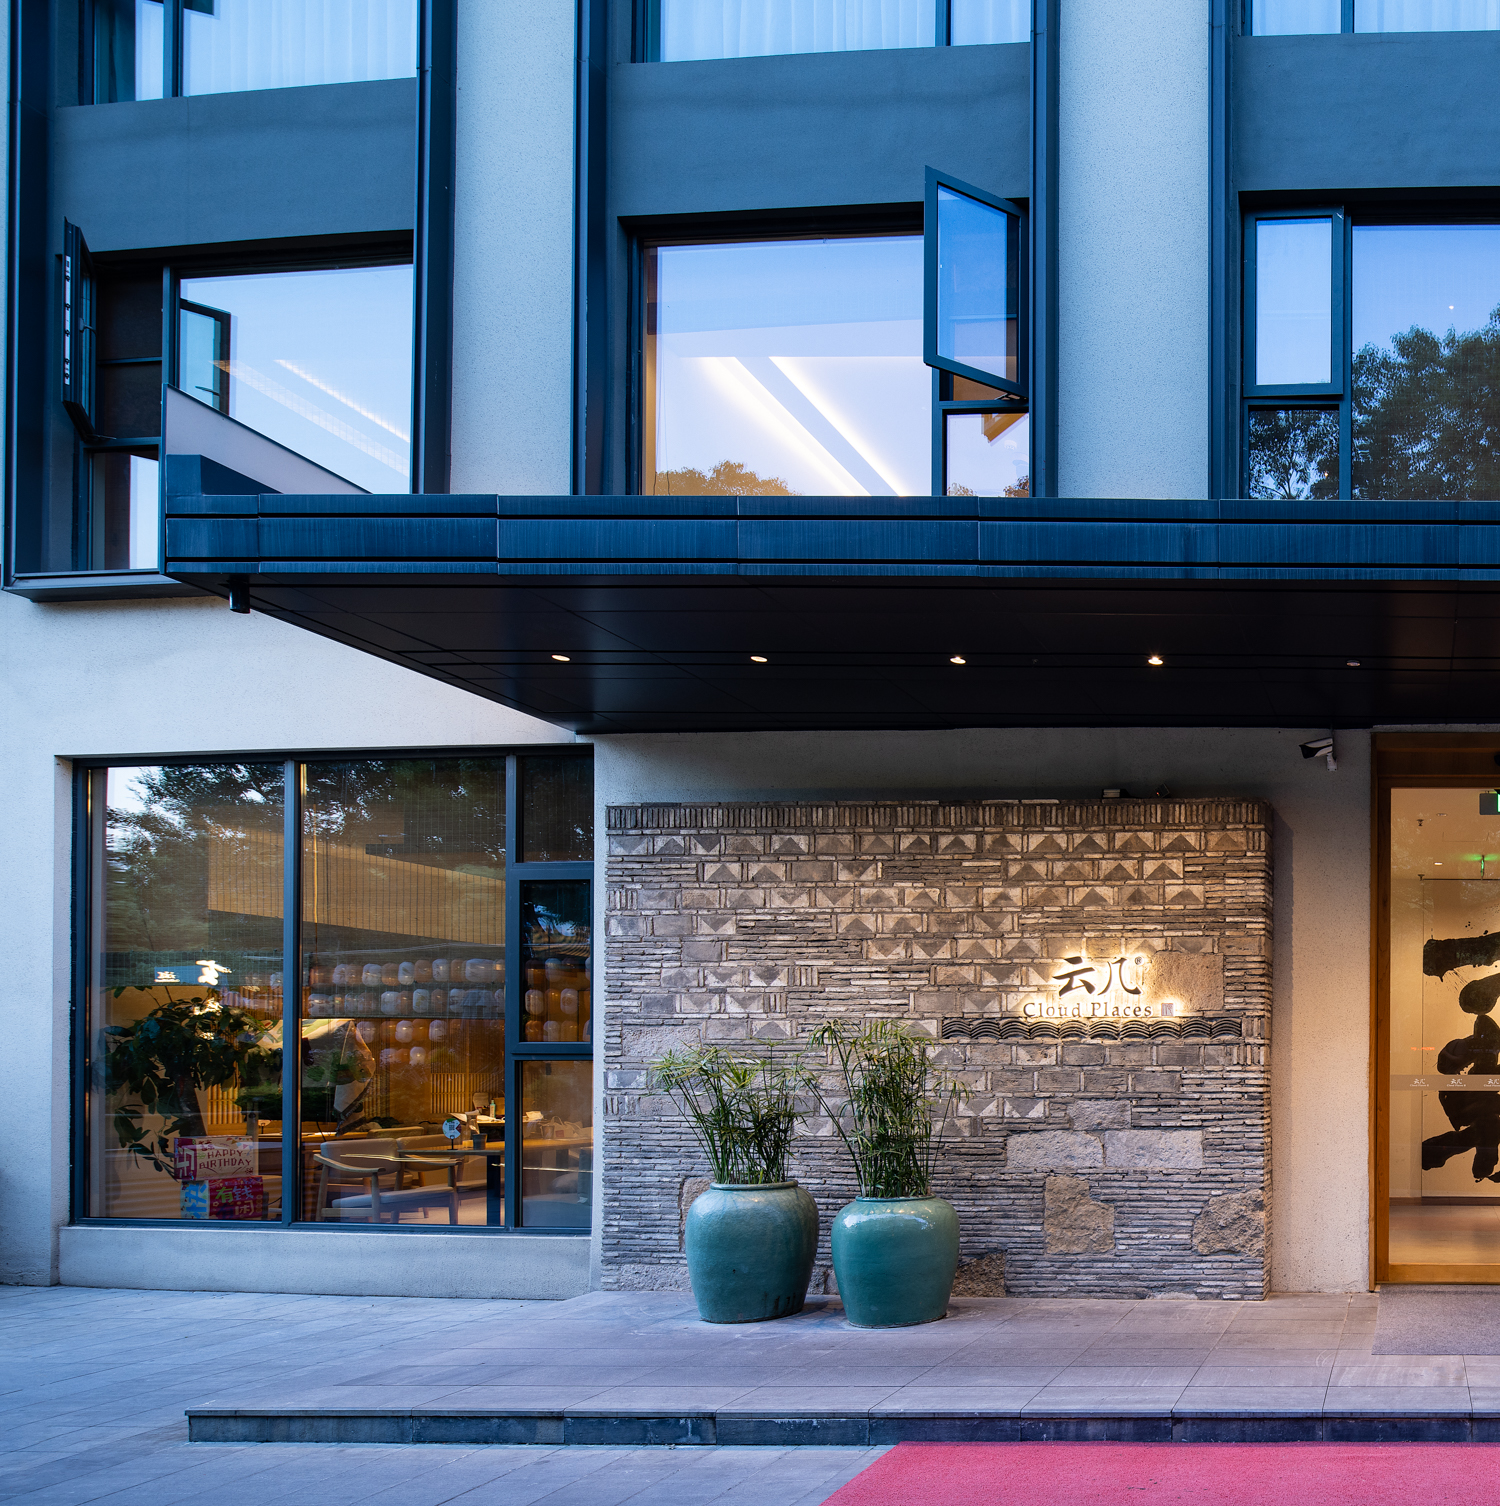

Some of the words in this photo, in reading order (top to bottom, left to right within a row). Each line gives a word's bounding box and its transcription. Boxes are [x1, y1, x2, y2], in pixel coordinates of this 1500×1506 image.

[1052, 956, 1142, 997] 云几
[1023, 1002, 1081, 1018] Cloud
[1091, 1002, 1152, 1018] Places
[207, 1148, 243, 1159] HAPPY
[199, 1157, 252, 1170] BIRTHDAY
